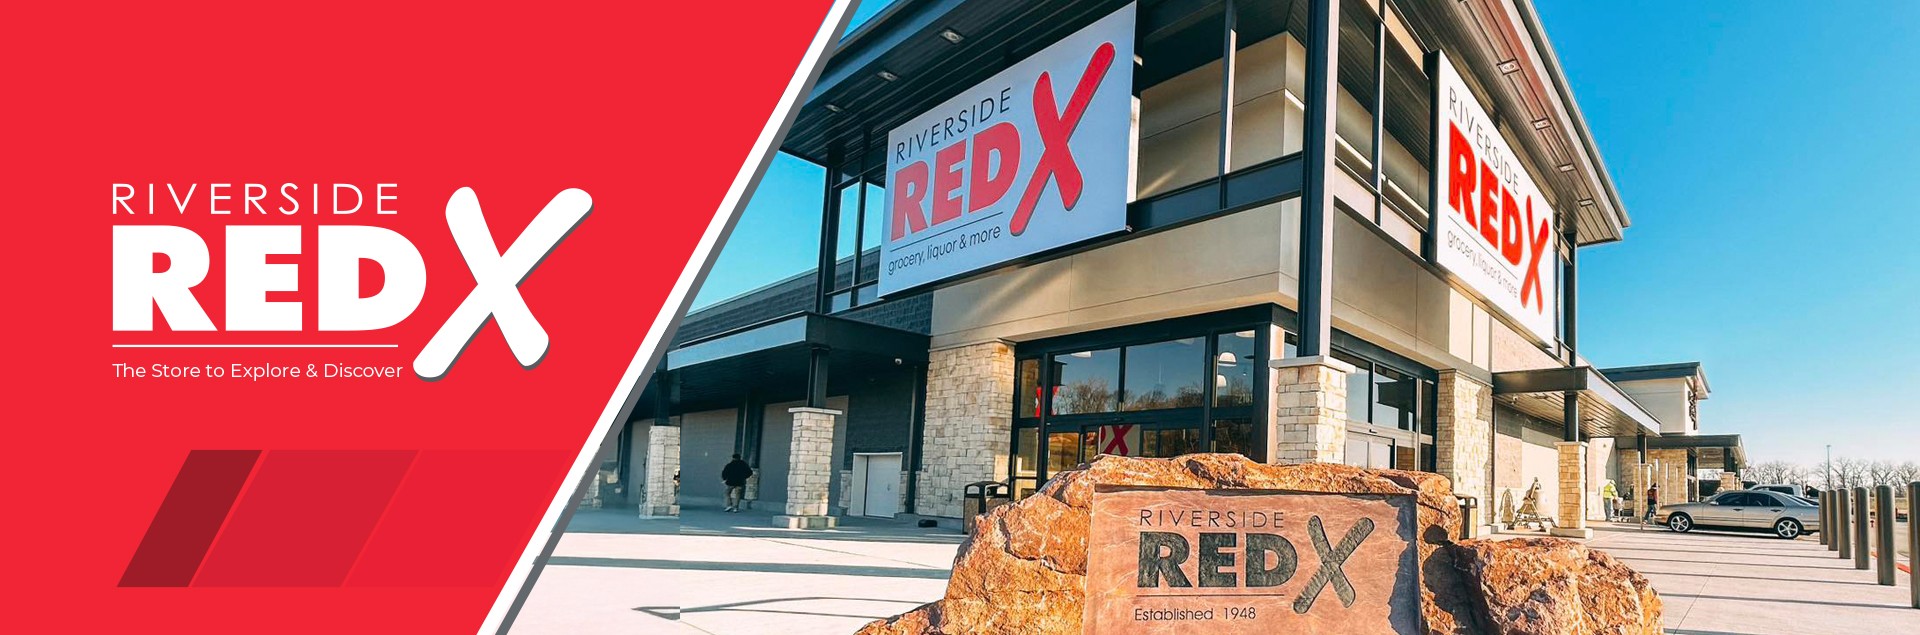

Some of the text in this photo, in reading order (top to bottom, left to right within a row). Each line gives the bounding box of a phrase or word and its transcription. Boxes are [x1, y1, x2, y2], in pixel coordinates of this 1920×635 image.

[896, 87, 1012, 164] RIVERSIDE
[1449, 86, 1519, 195] RIVERSIDE
[888, 226, 1001, 275] grocery, liquor & more
[1139, 509, 1285, 529] RIVERSIDE
[1134, 607, 1256, 621] Established 1948
